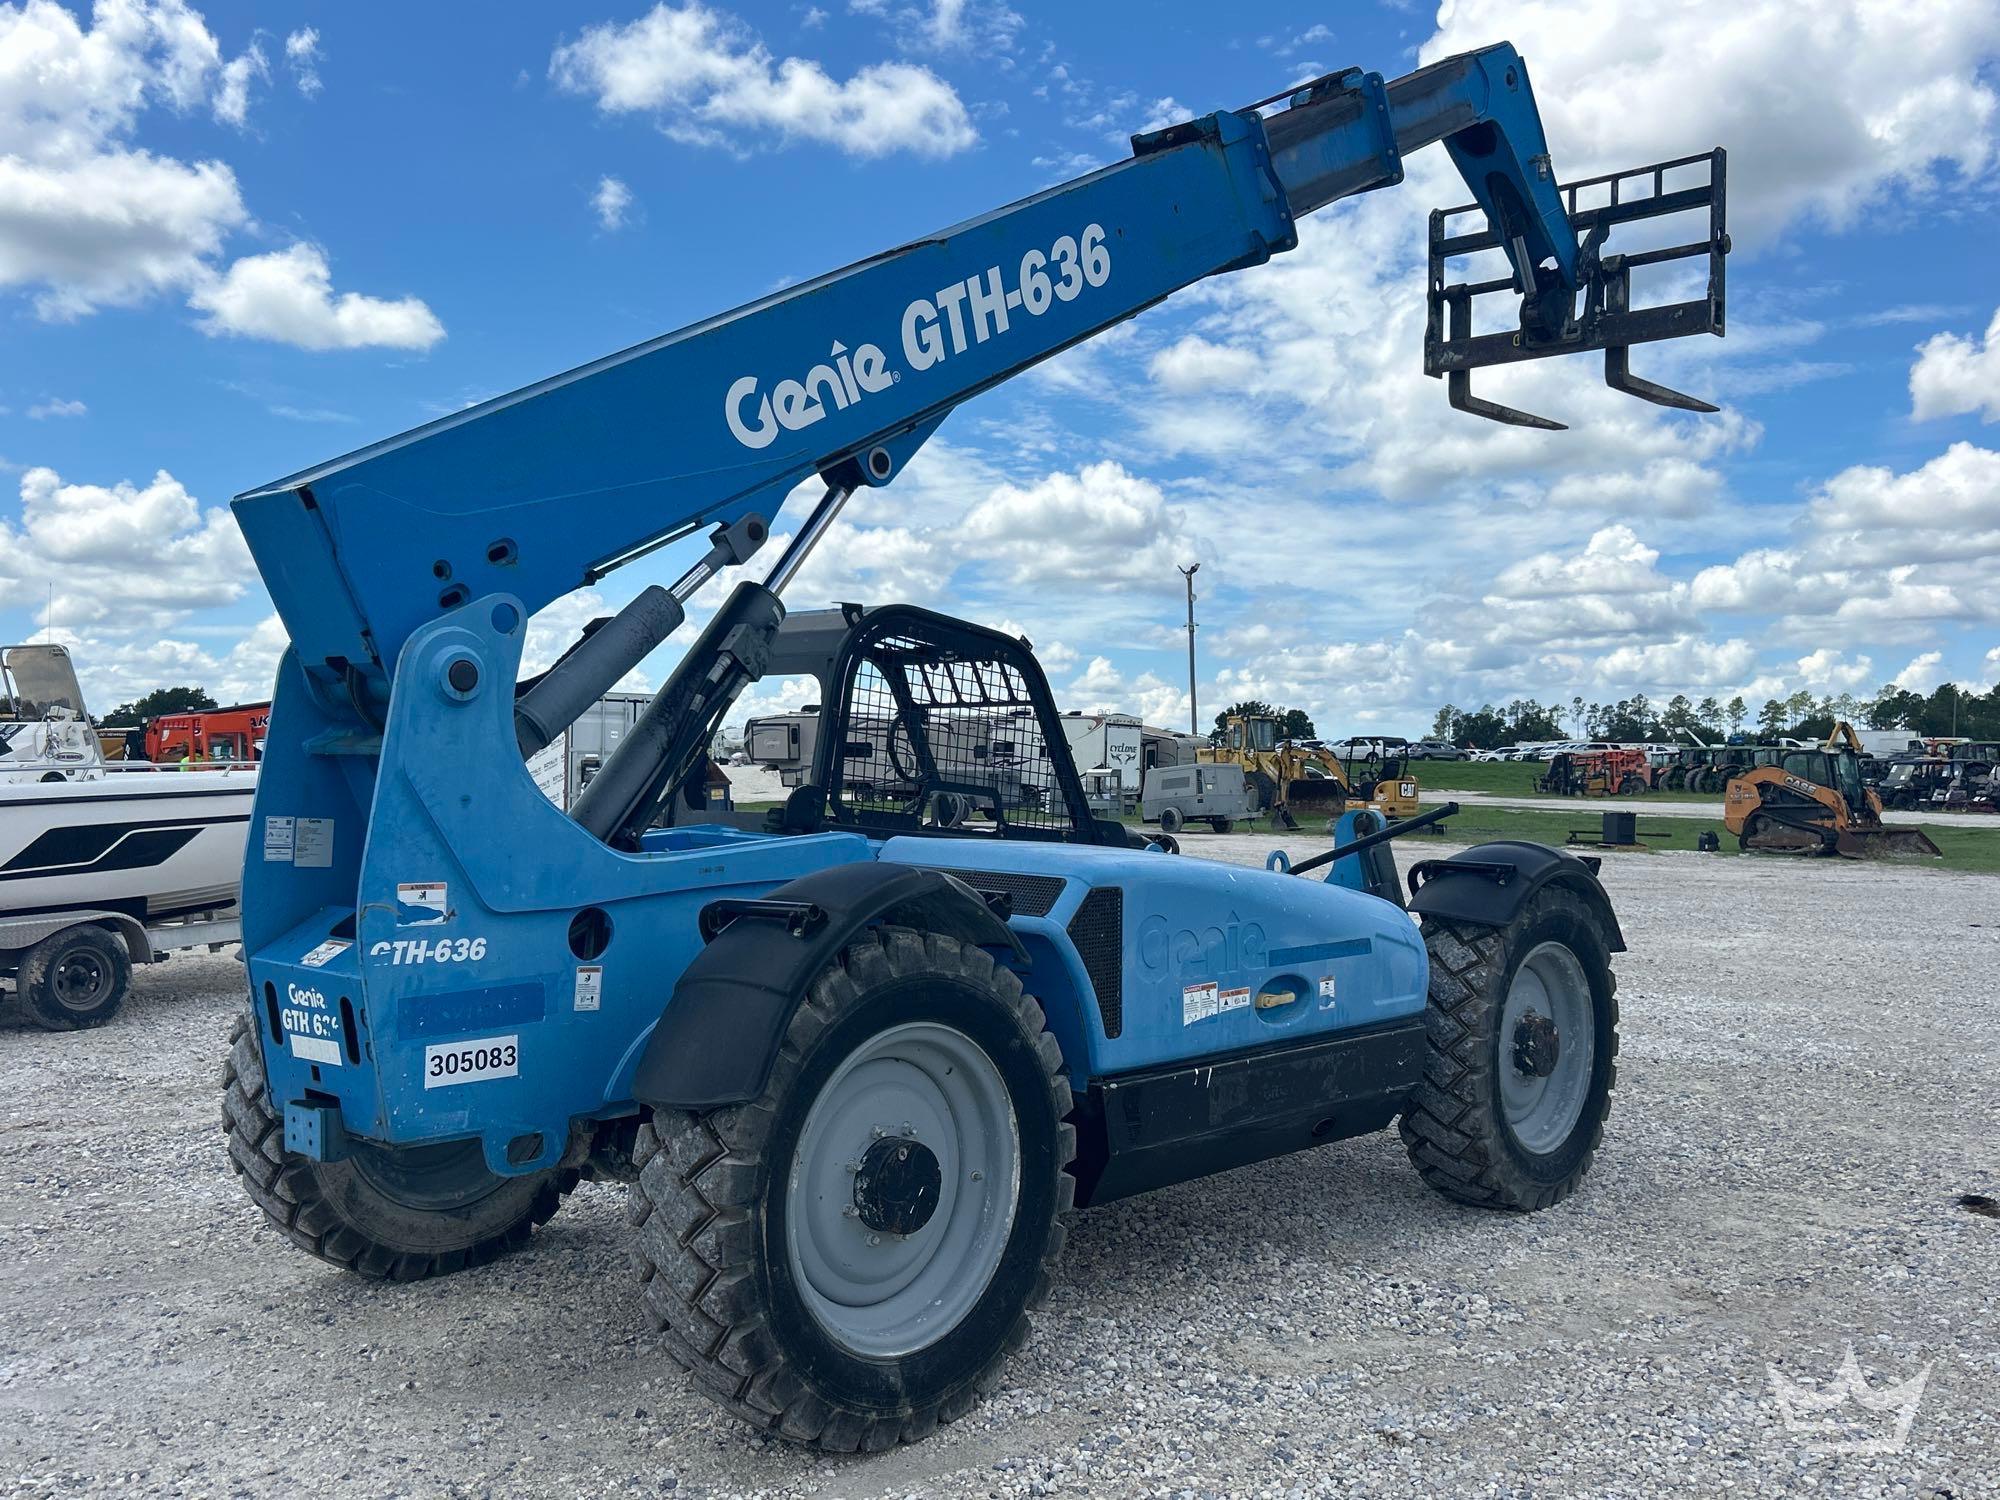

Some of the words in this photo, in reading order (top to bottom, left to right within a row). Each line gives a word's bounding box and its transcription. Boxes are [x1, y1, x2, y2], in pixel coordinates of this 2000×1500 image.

[725, 339, 893, 449] Genie
[901, 223, 1111, 371] GTH-636
[1401, 783, 1415, 797] CAT
[1784, 776, 1817, 793] CASE
[282, 1008, 310, 1034] GTH
[429, 1045, 517, 1077] 305083
